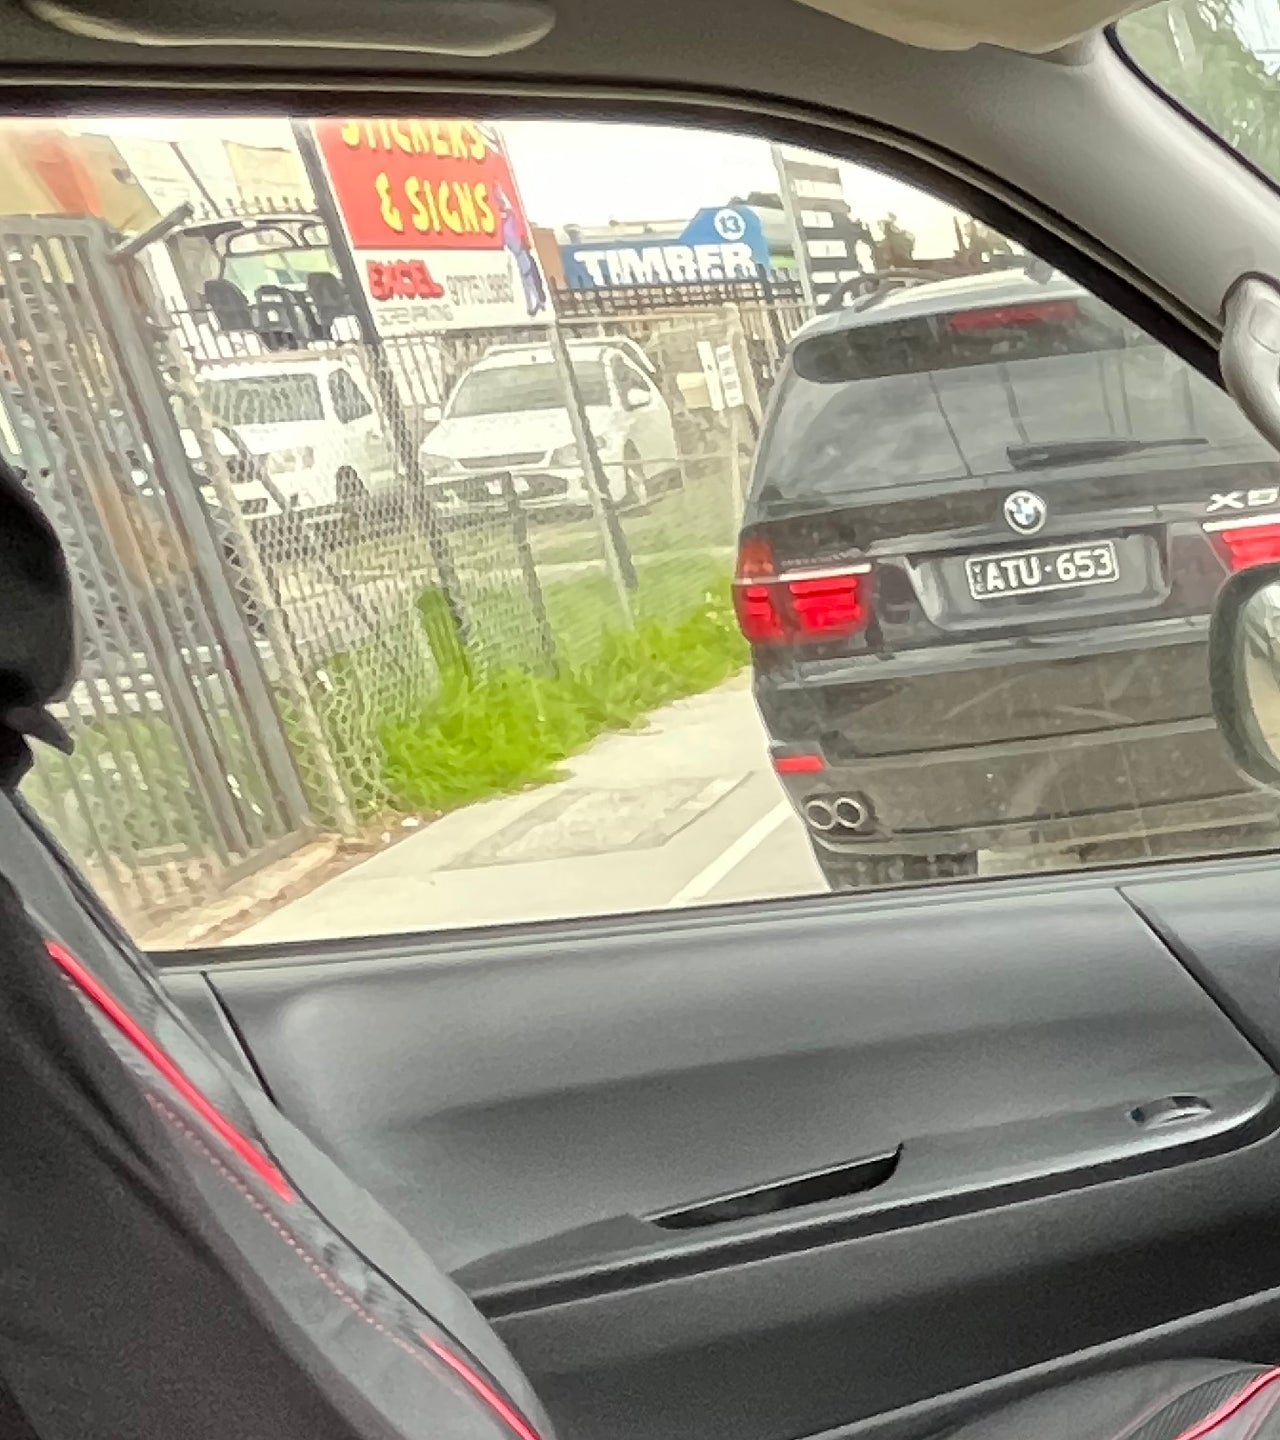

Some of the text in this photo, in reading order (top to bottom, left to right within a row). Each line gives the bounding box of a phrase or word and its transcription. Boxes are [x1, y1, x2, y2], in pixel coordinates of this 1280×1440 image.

[375, 172, 496, 235] & SIGNS
[719, 215, 741, 235] 13
[573, 242, 758, 287] TIMBER
